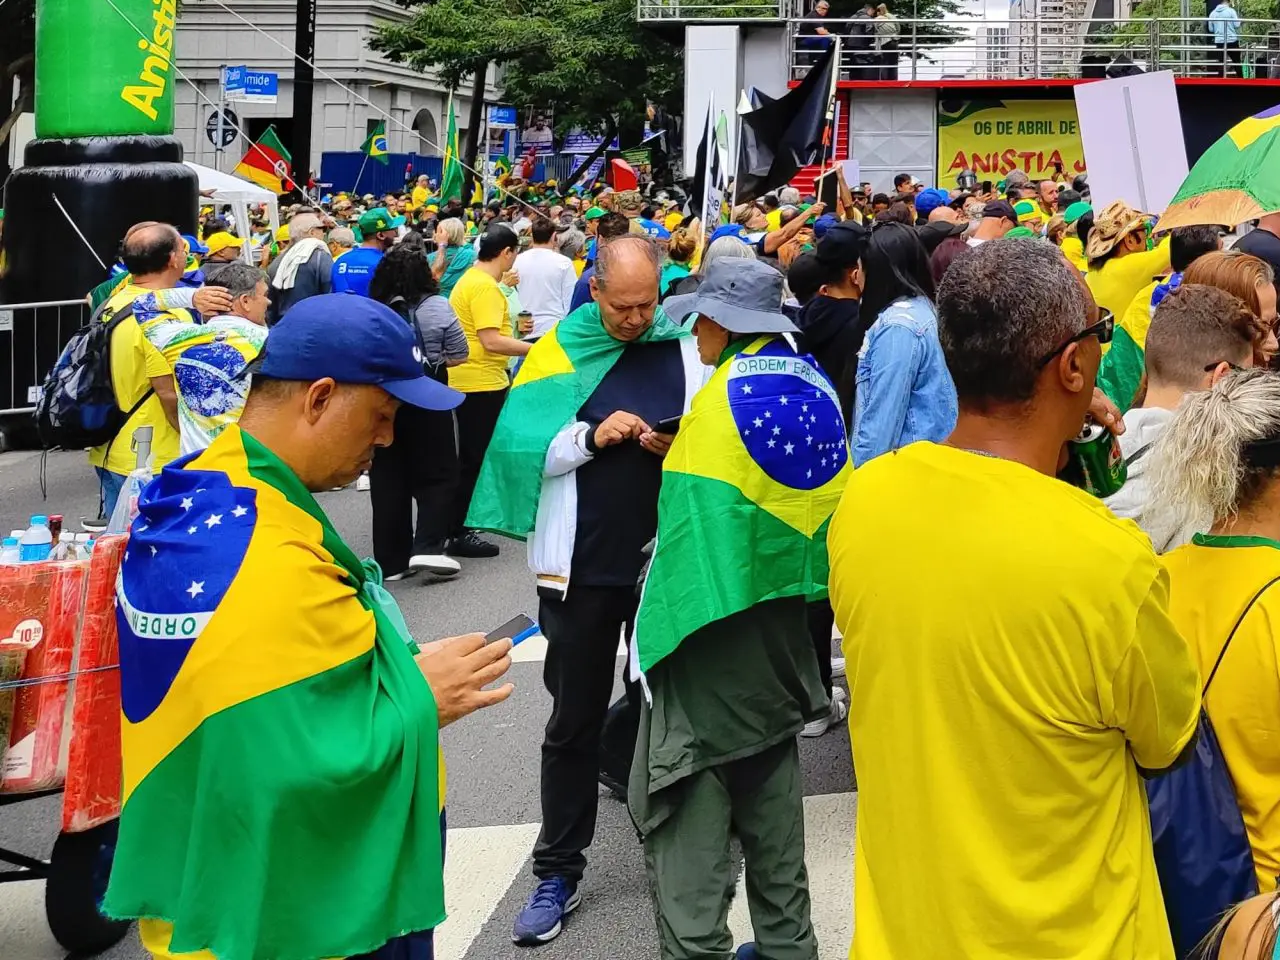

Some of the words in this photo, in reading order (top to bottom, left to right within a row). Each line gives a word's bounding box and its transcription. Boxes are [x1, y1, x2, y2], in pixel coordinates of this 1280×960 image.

[973, 121, 992, 136] 06
[996, 121, 1014, 135] DE
[1017, 121, 1055, 135] ABRIL
[1059, 120, 1077, 135] DE
[947, 148, 1065, 176] ANISTIA
[737, 359, 787, 373] ORDEM
[132, 612, 197, 636] ORDEM
